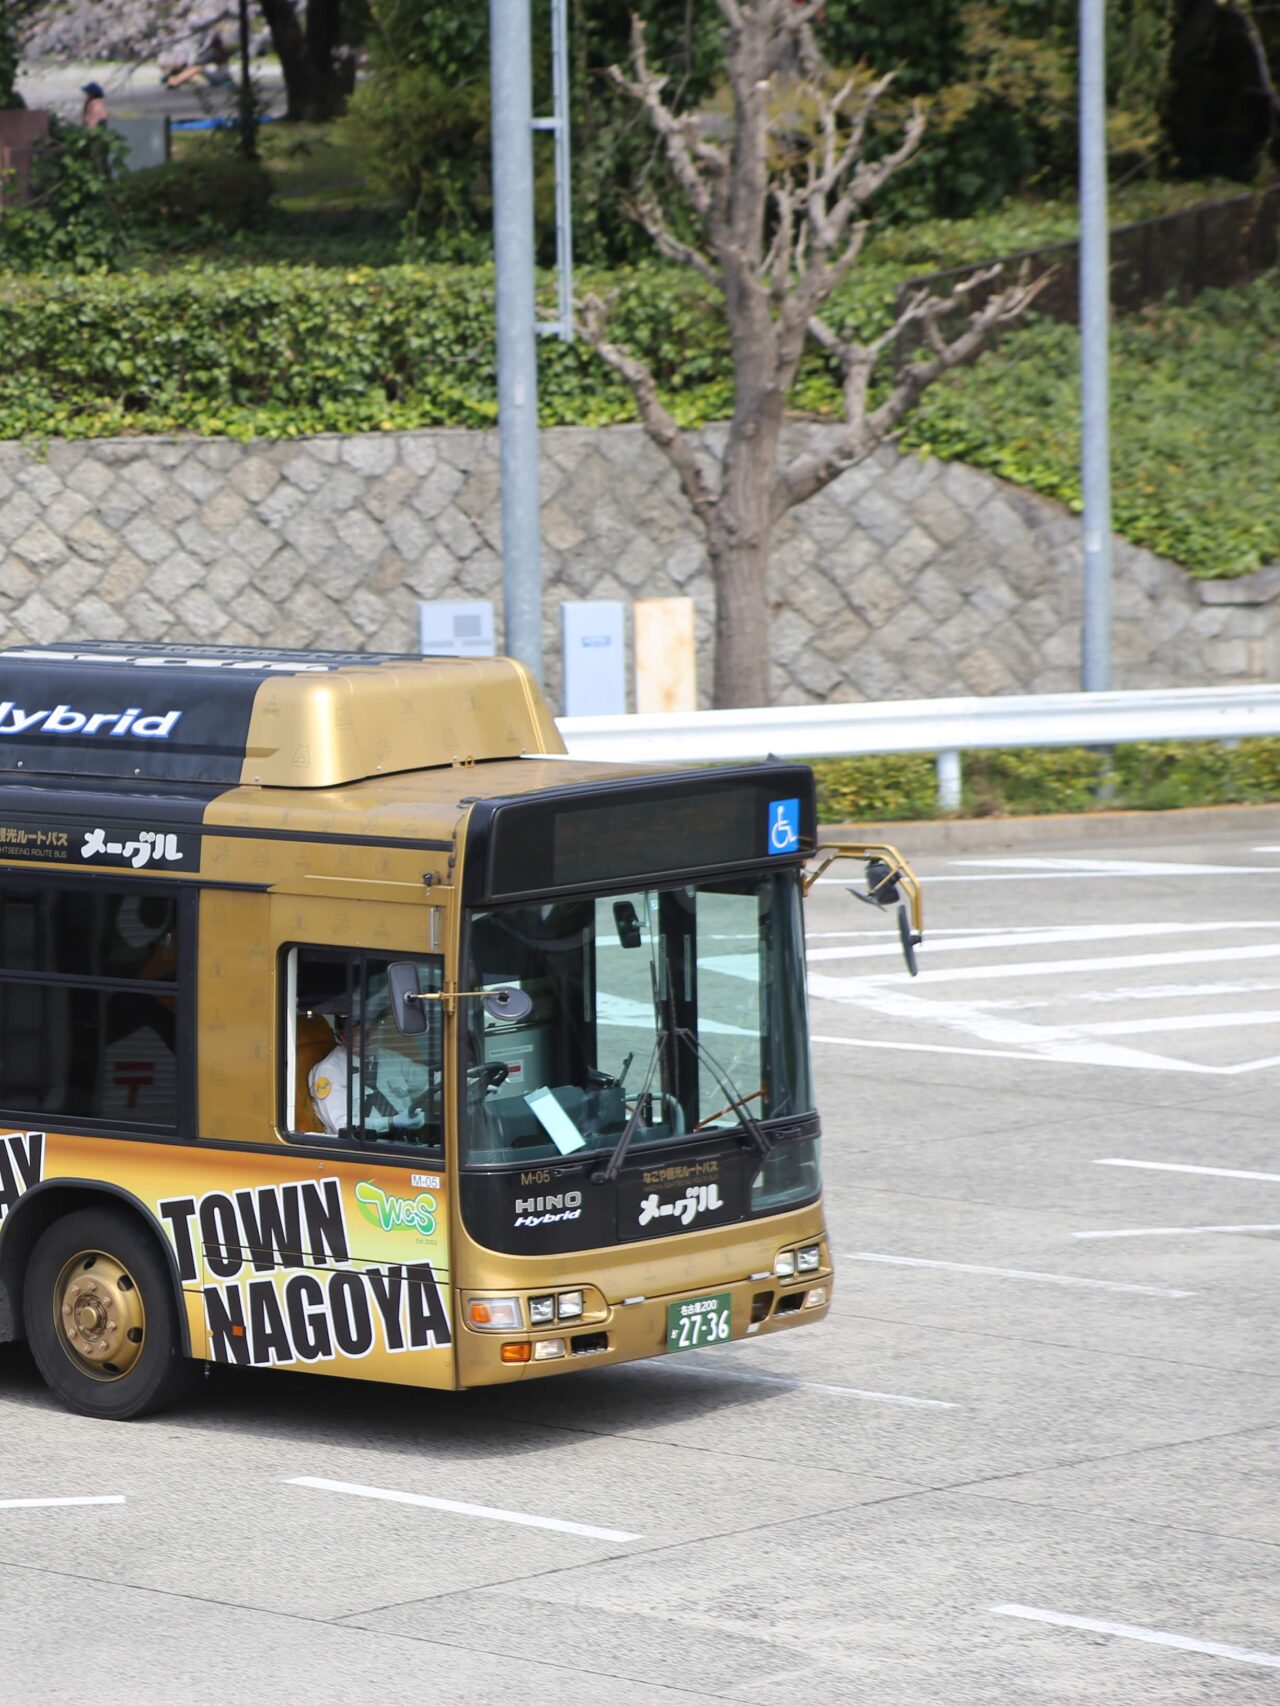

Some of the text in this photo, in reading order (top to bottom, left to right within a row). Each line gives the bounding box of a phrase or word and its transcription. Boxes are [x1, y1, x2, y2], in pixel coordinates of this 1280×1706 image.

[31, 848, 52, 857] ROUTE
[54, 850, 67, 858] BUS
[80, 828, 183, 869] メーグル
[412, 1174, 439, 1188] M-05
[521, 1170, 551, 1185] M-05
[514, 1208, 582, 1227] Hybrid
[515, 1191, 582, 1214] HINO
[638, 1183, 724, 1226] メーグル
[159, 1177, 352, 1284] TOWN
[204, 1259, 451, 1366] NAGOYA
[678, 1309, 729, 1347] 27-36
